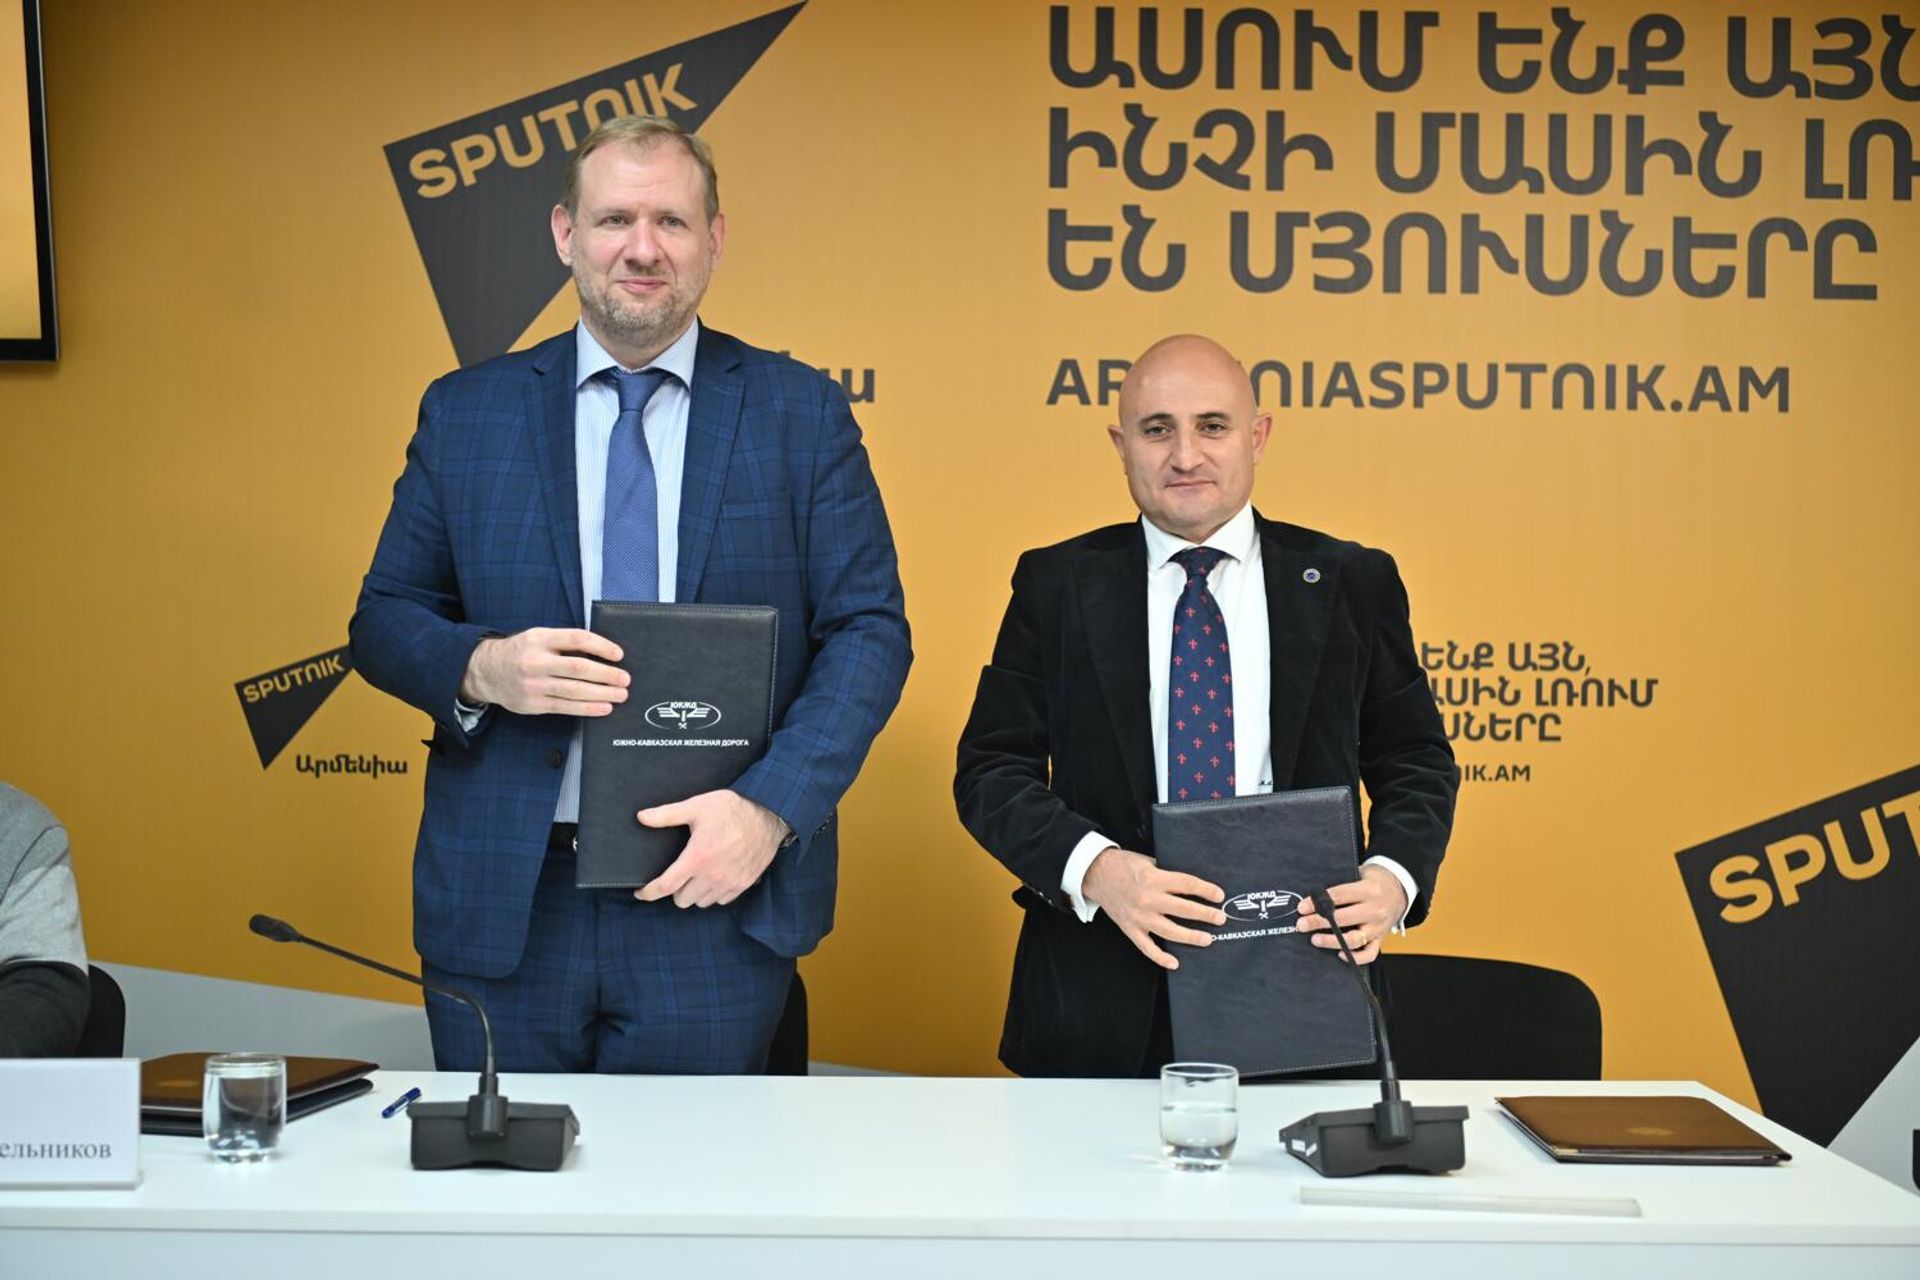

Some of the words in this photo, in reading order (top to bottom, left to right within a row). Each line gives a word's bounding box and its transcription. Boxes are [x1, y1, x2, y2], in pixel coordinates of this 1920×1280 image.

[1049, 5, 1439, 93] ԱՍՈՒՄ
[1477, 7, 1686, 96] ԵՆՔ
[409, 63, 698, 199] SPUTNIK
[1049, 103, 1334, 191] ԻՆՉԻ
[1375, 110, 1762, 198] ՄԱՍԻՆ
[1047, 204, 1187, 292] ԵՆ
[1046, 358, 1790, 413] ARNIASPUTNIK.AM
[243, 654, 345, 703] SPUTNIK
[1420, 640, 1494, 670] ԵՆՔ
[1429, 676, 1521, 707] ՍԻՆ
[612, 738, 682, 747] ЮЖНО-КАВКАЗСКАЯ
[684, 738, 721, 747] ЖЕЛЕЗНАЯ
[721, 738, 749, 747] ДОРОГА
[1441, 711, 1562, 742] ՍՆԵՐԸ
[1211, 929, 1266, 942] О-КАВКАЗСКАЯ
[1267, 926, 1298, 936] ЖЕЛЕЗН
